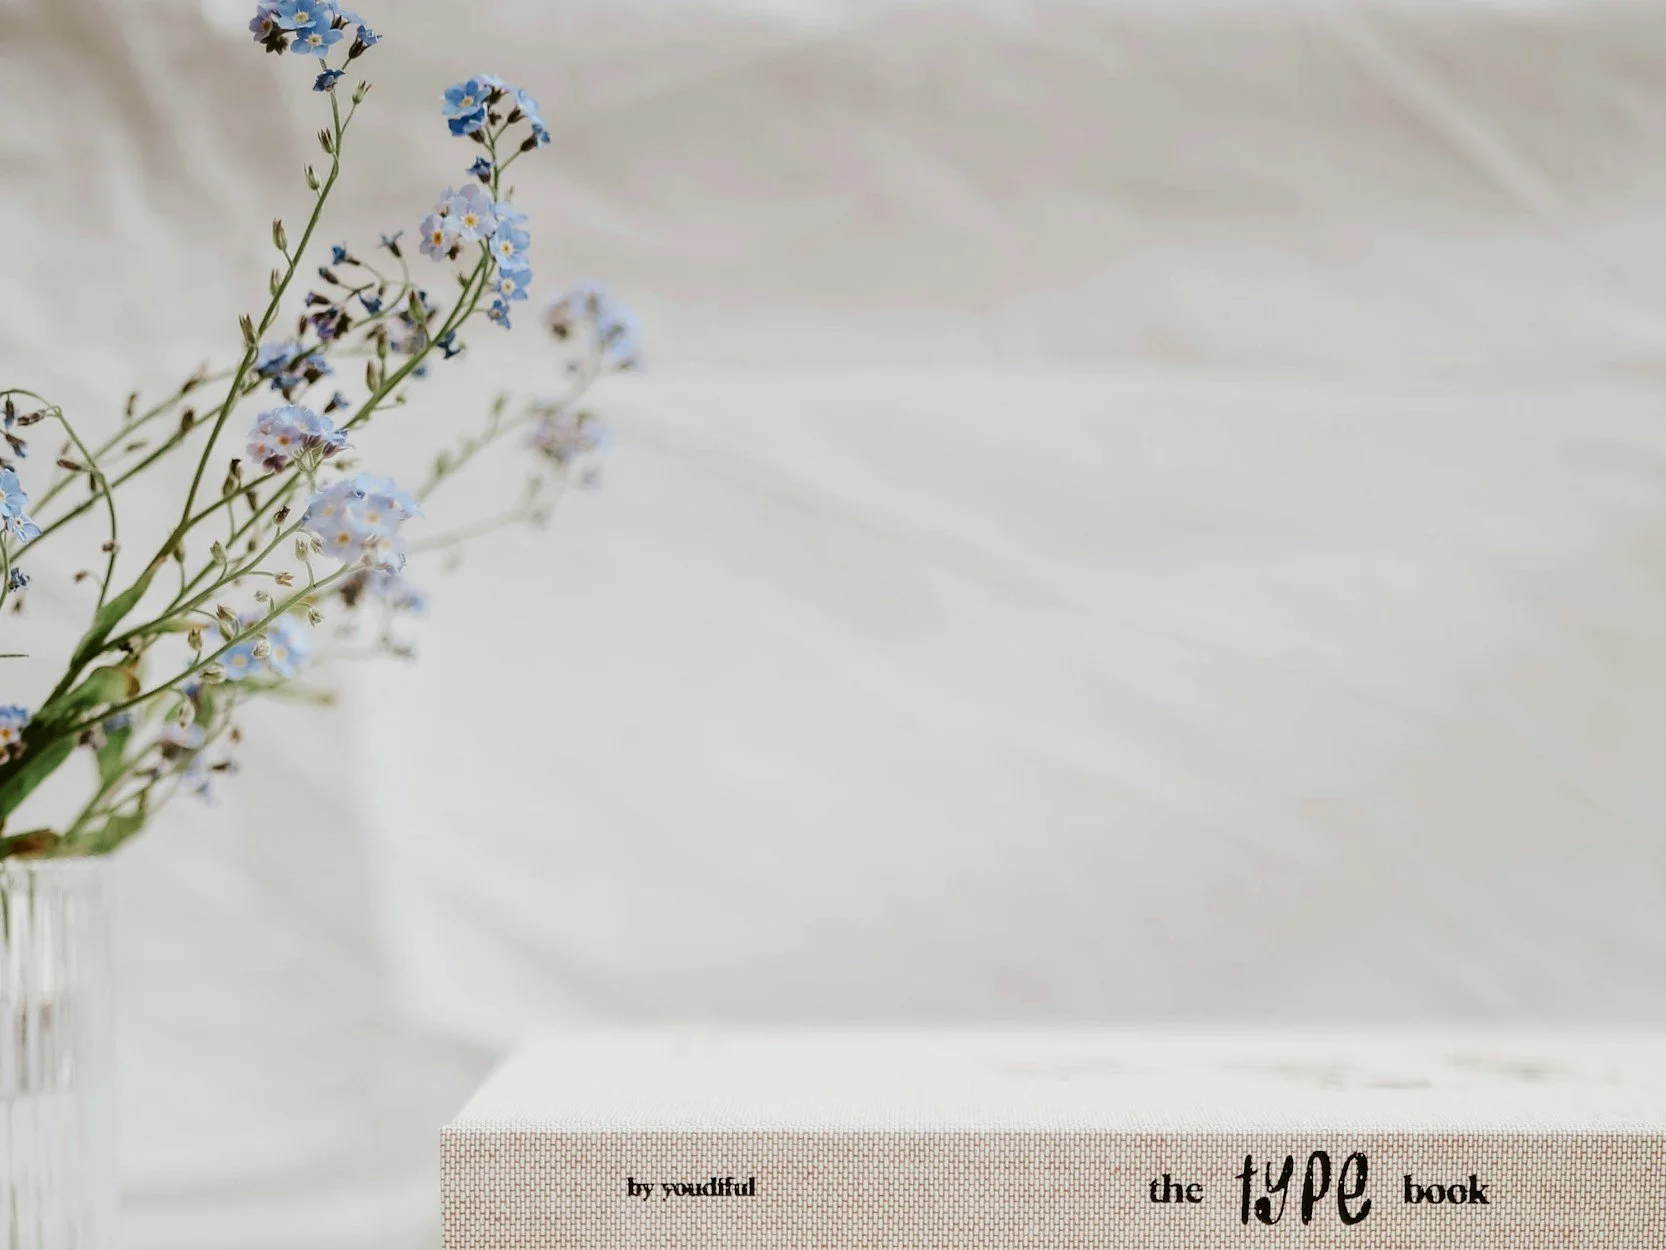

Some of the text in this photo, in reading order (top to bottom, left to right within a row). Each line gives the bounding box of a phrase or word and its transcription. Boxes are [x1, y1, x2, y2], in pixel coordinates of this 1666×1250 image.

[627, 1176, 756, 1202] by youdiful
[1149, 1150, 1490, 1226] the type book
